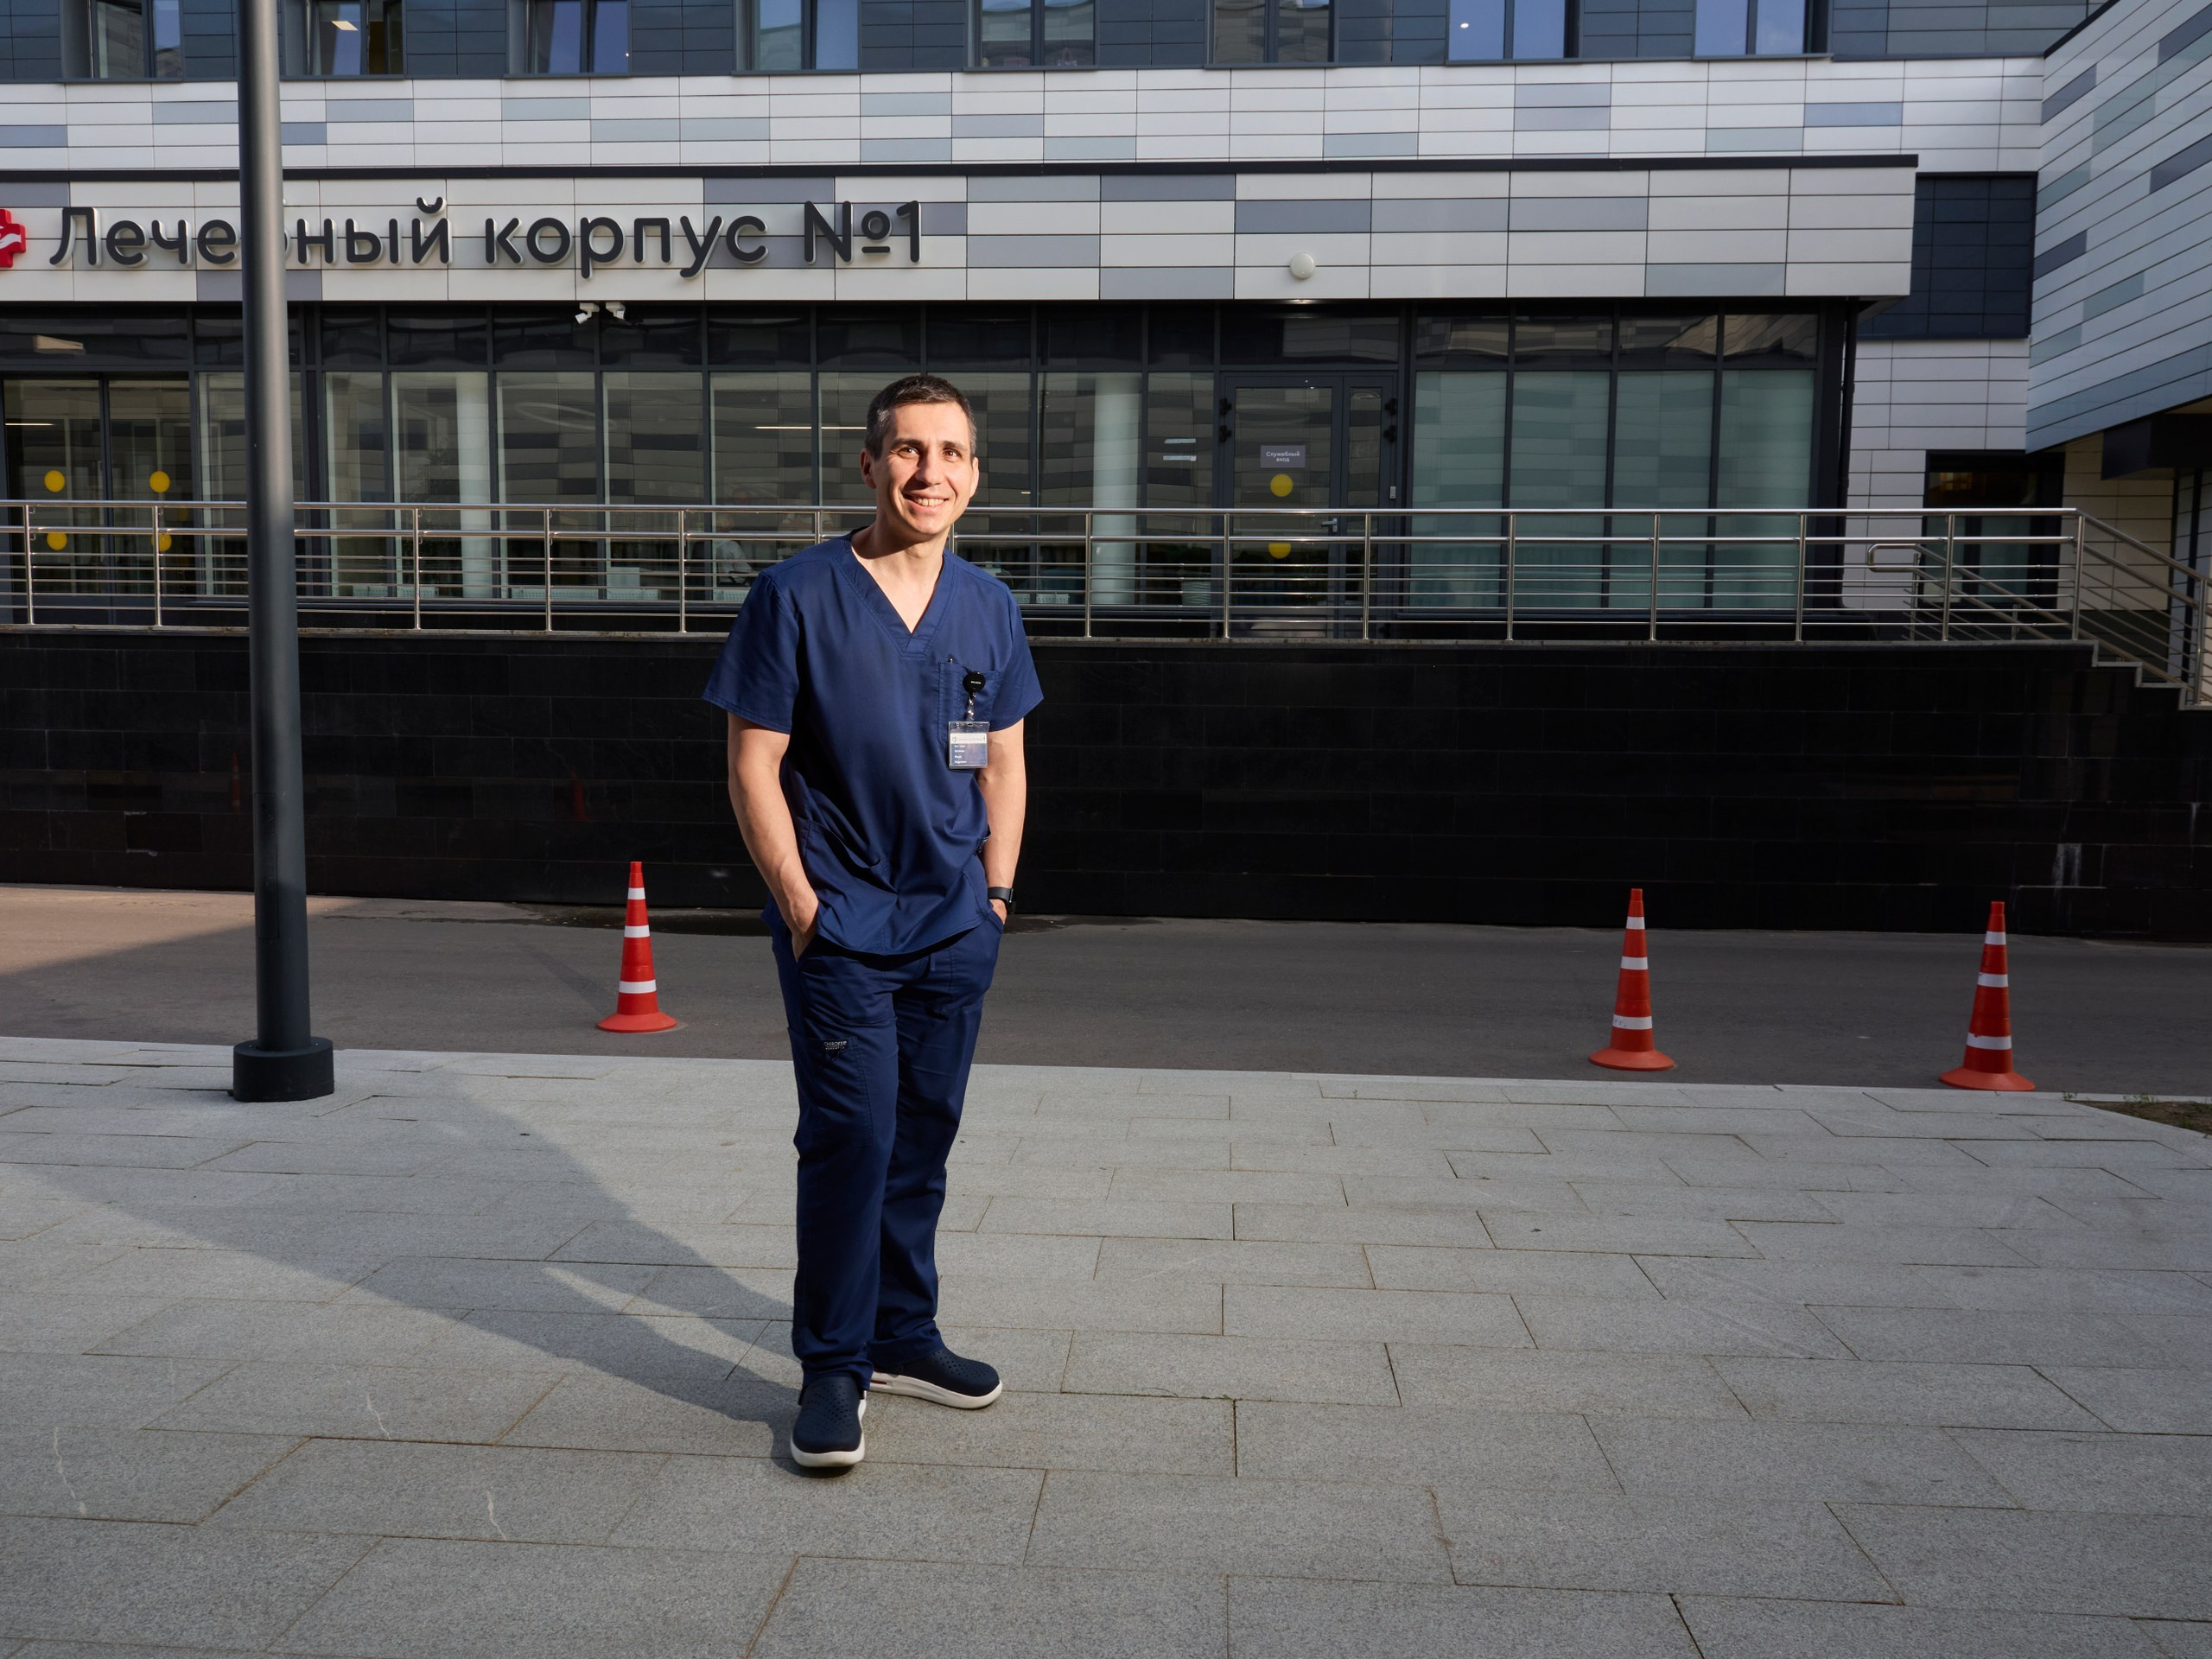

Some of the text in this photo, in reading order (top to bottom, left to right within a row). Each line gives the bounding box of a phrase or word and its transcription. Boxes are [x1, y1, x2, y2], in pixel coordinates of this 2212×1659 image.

[49, 196, 921, 279] Леченый корпус №1
